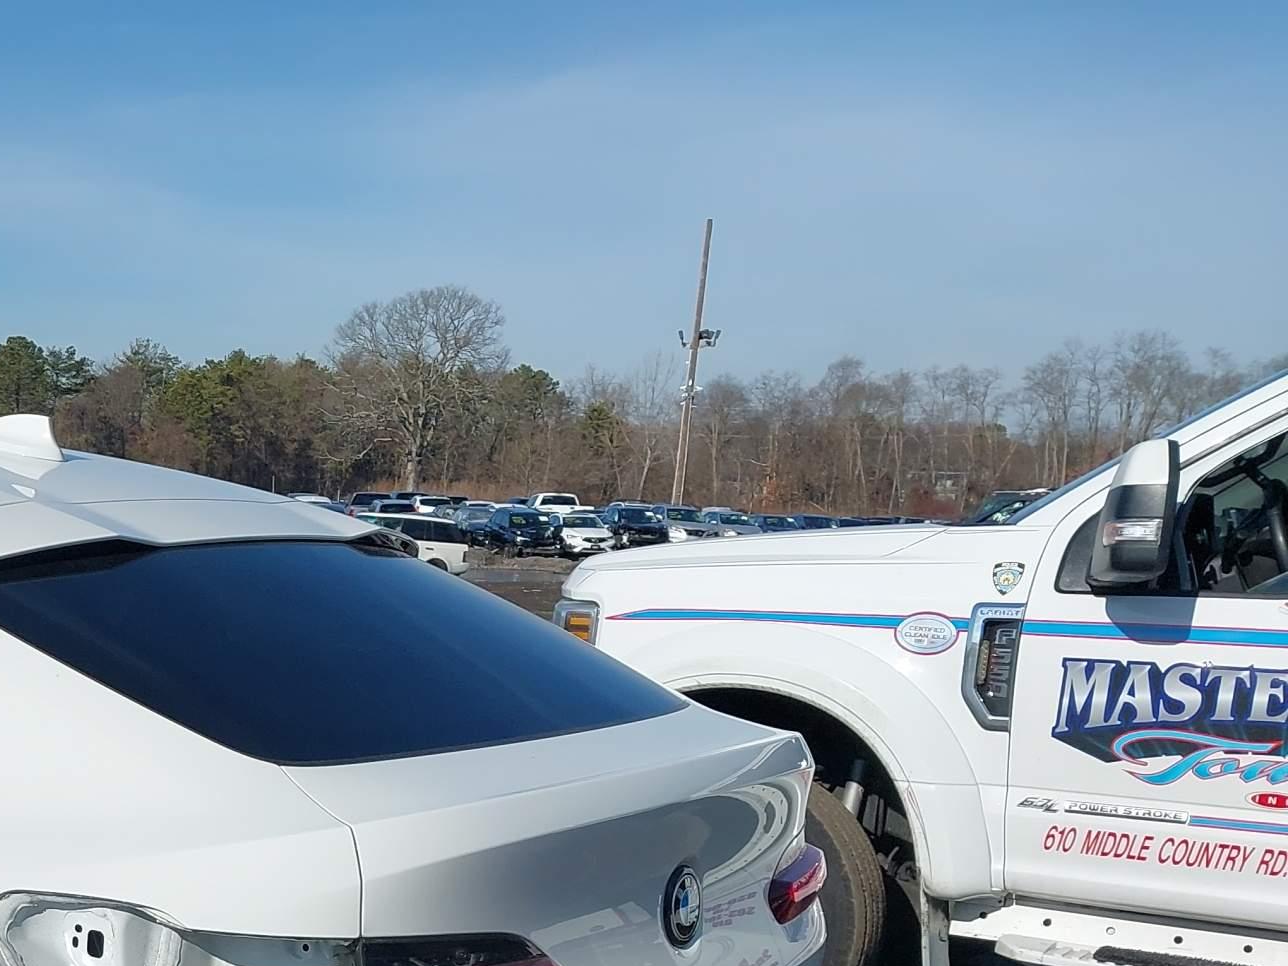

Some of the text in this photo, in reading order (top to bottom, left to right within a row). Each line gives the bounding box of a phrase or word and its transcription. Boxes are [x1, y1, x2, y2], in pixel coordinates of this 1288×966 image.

[904, 631, 929, 639] CLEAN
[1255, 794, 1288, 806] IN
[1068, 802, 1119, 814] POWER
[1123, 806, 1183, 820] STROKE
[1043, 825, 1077, 853] 610
[1080, 829, 1155, 861] MIDDLE
[1158, 837, 1256, 873] COUNTRY
